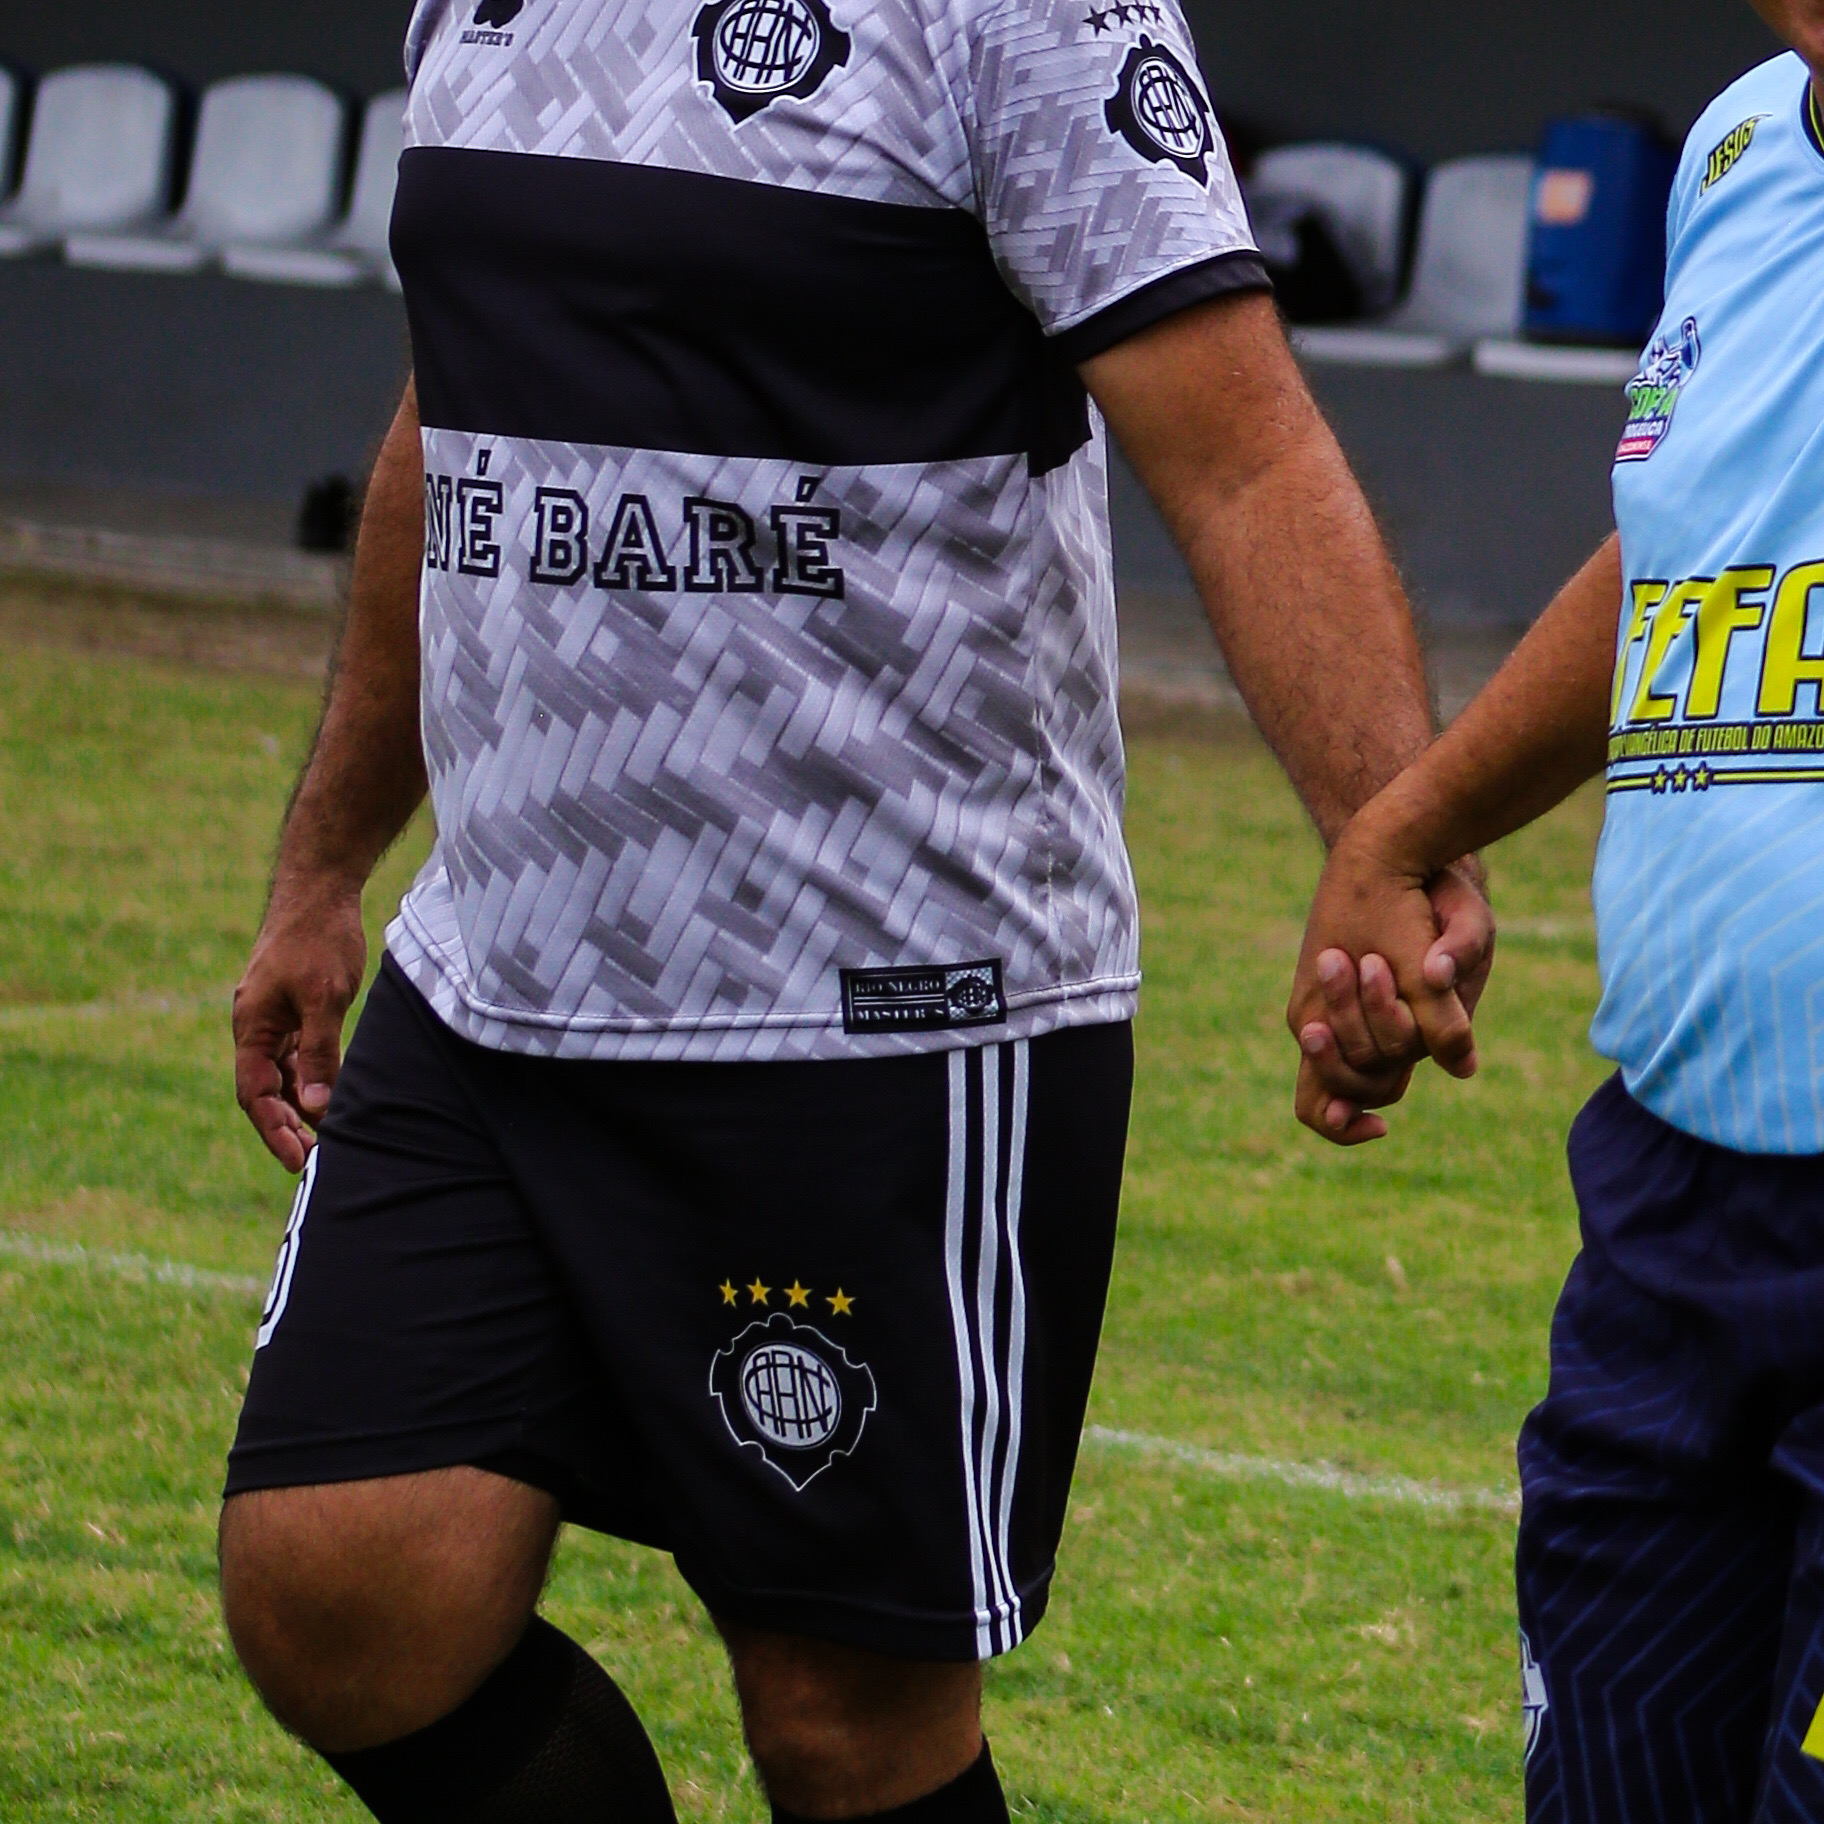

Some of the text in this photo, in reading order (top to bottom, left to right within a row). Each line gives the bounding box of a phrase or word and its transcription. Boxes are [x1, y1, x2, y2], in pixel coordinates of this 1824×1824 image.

[529, 474, 846, 600] BARÉ
[1697, 726, 1749, 753] FUTEBOL
[1751, 725, 1772, 750] DO
